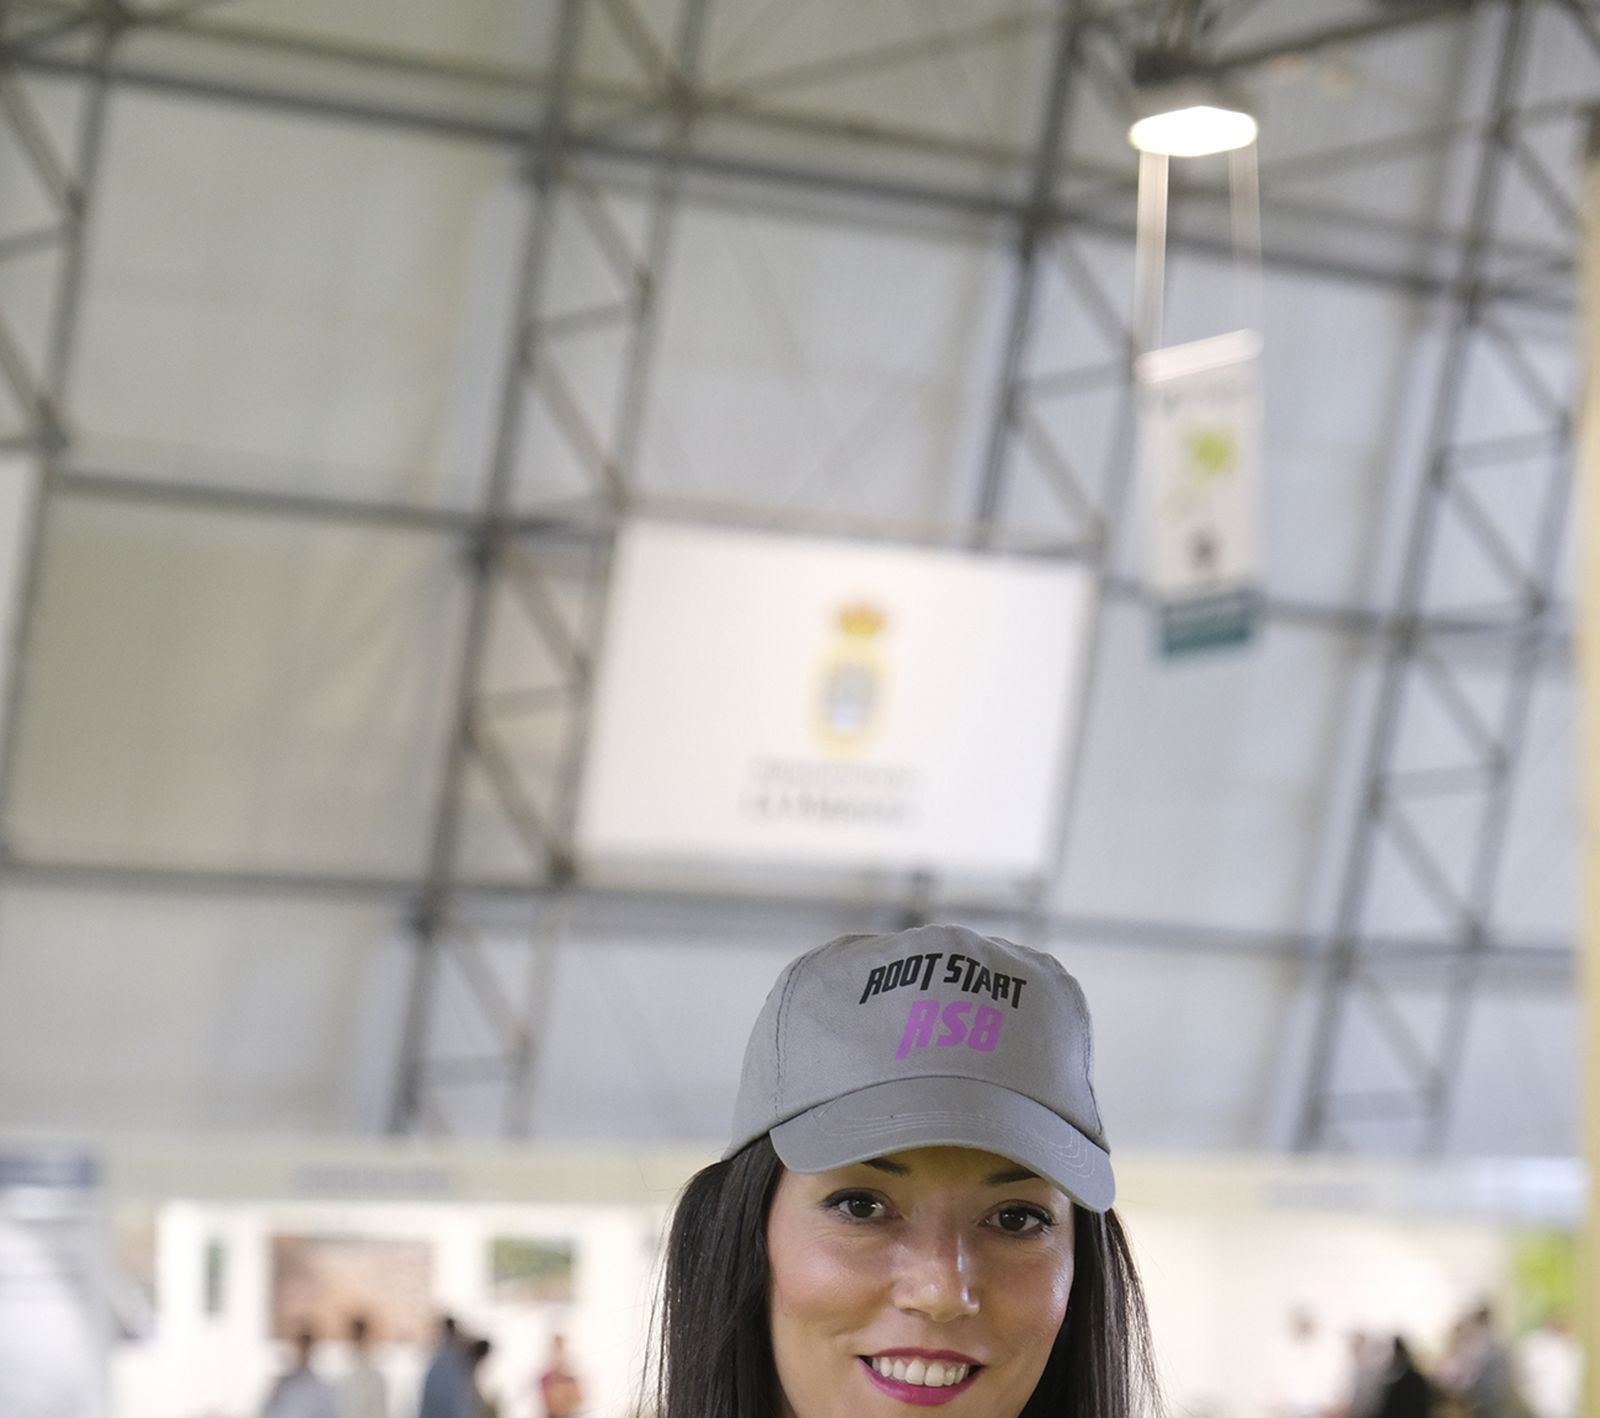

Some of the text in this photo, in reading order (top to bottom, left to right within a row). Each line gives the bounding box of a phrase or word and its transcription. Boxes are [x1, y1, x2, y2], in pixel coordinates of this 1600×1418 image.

[858, 953, 1027, 1009] ROOT START
[896, 999, 1005, 1060] RS8
